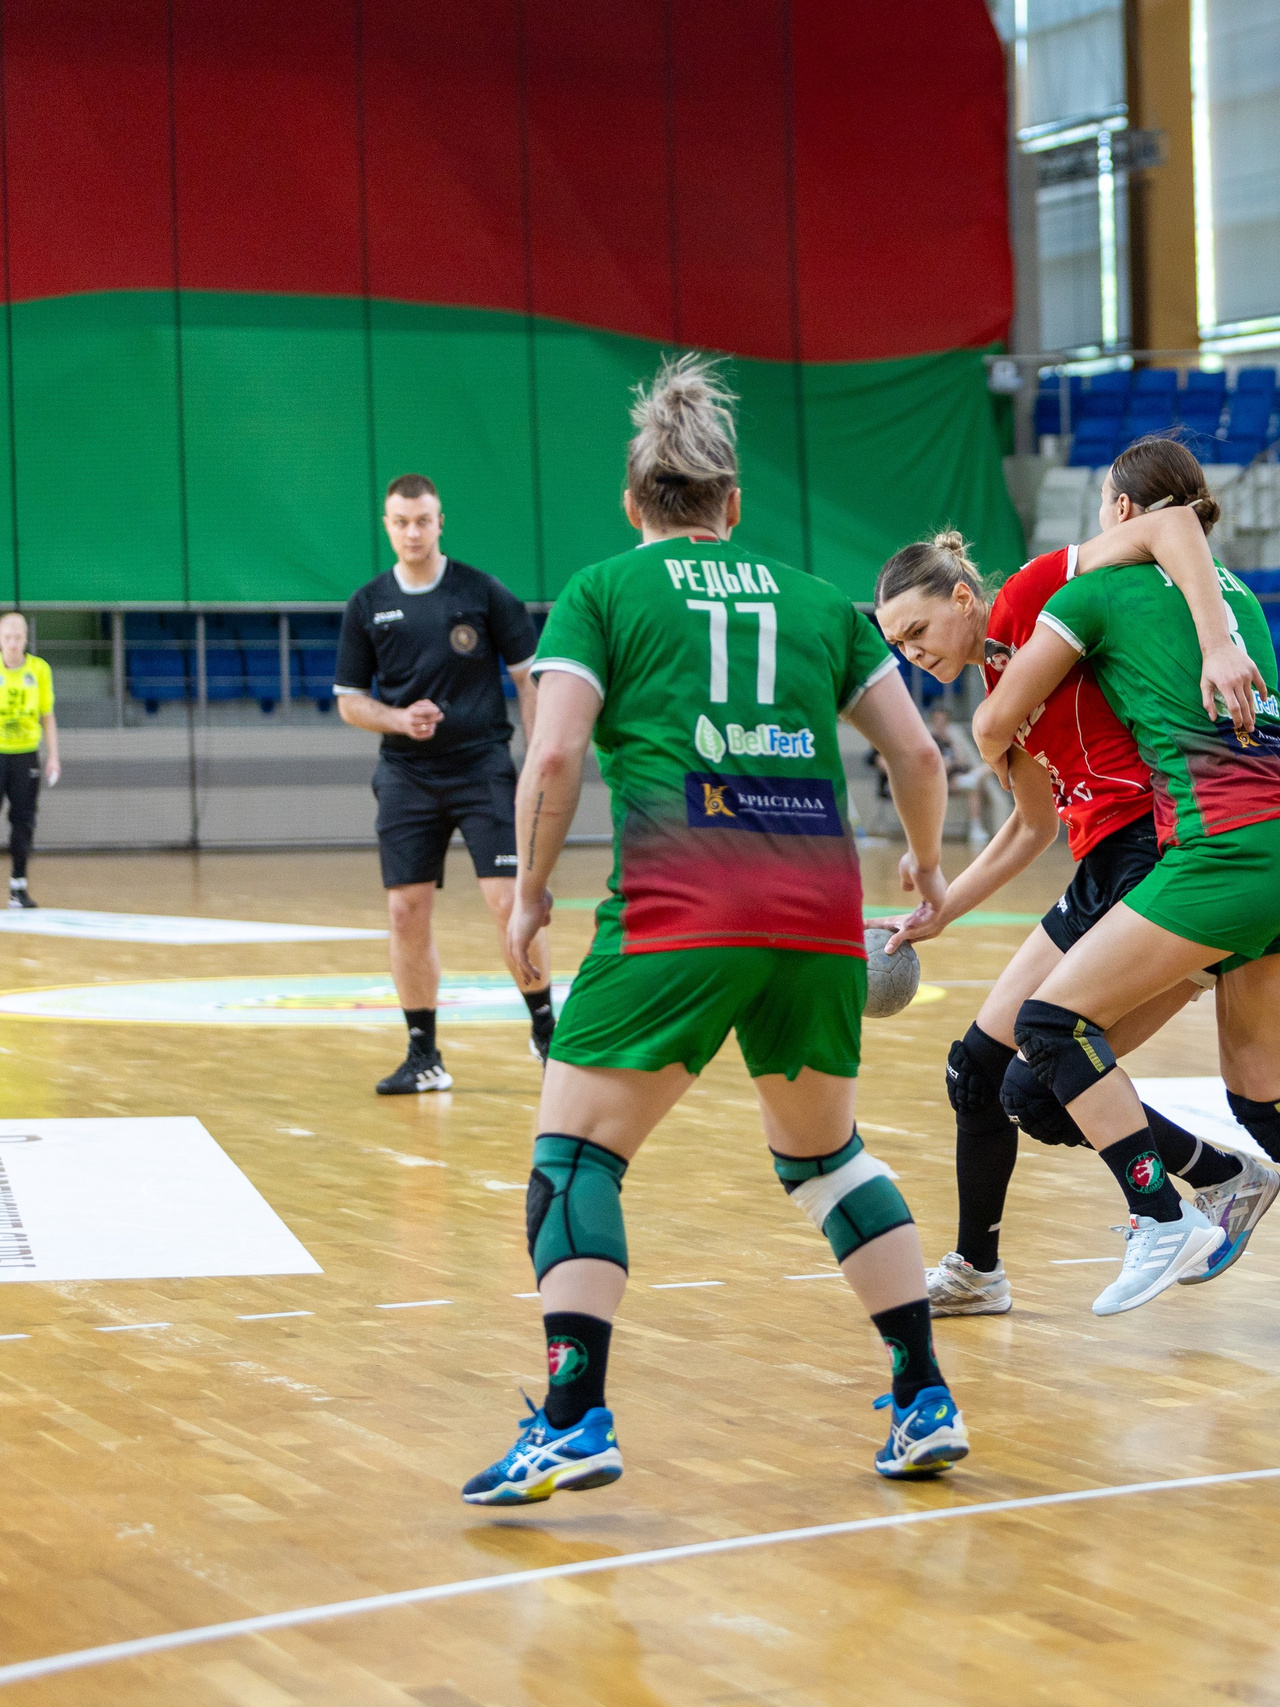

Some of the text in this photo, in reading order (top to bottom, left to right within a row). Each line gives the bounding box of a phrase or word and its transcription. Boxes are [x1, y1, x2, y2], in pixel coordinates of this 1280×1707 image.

[664, 559, 780, 598] РЕДЬКА
[685, 599, 777, 704] 77
[727, 724, 815, 757] BelFert
[738, 793, 825, 809] КРИСТАЛЛ
